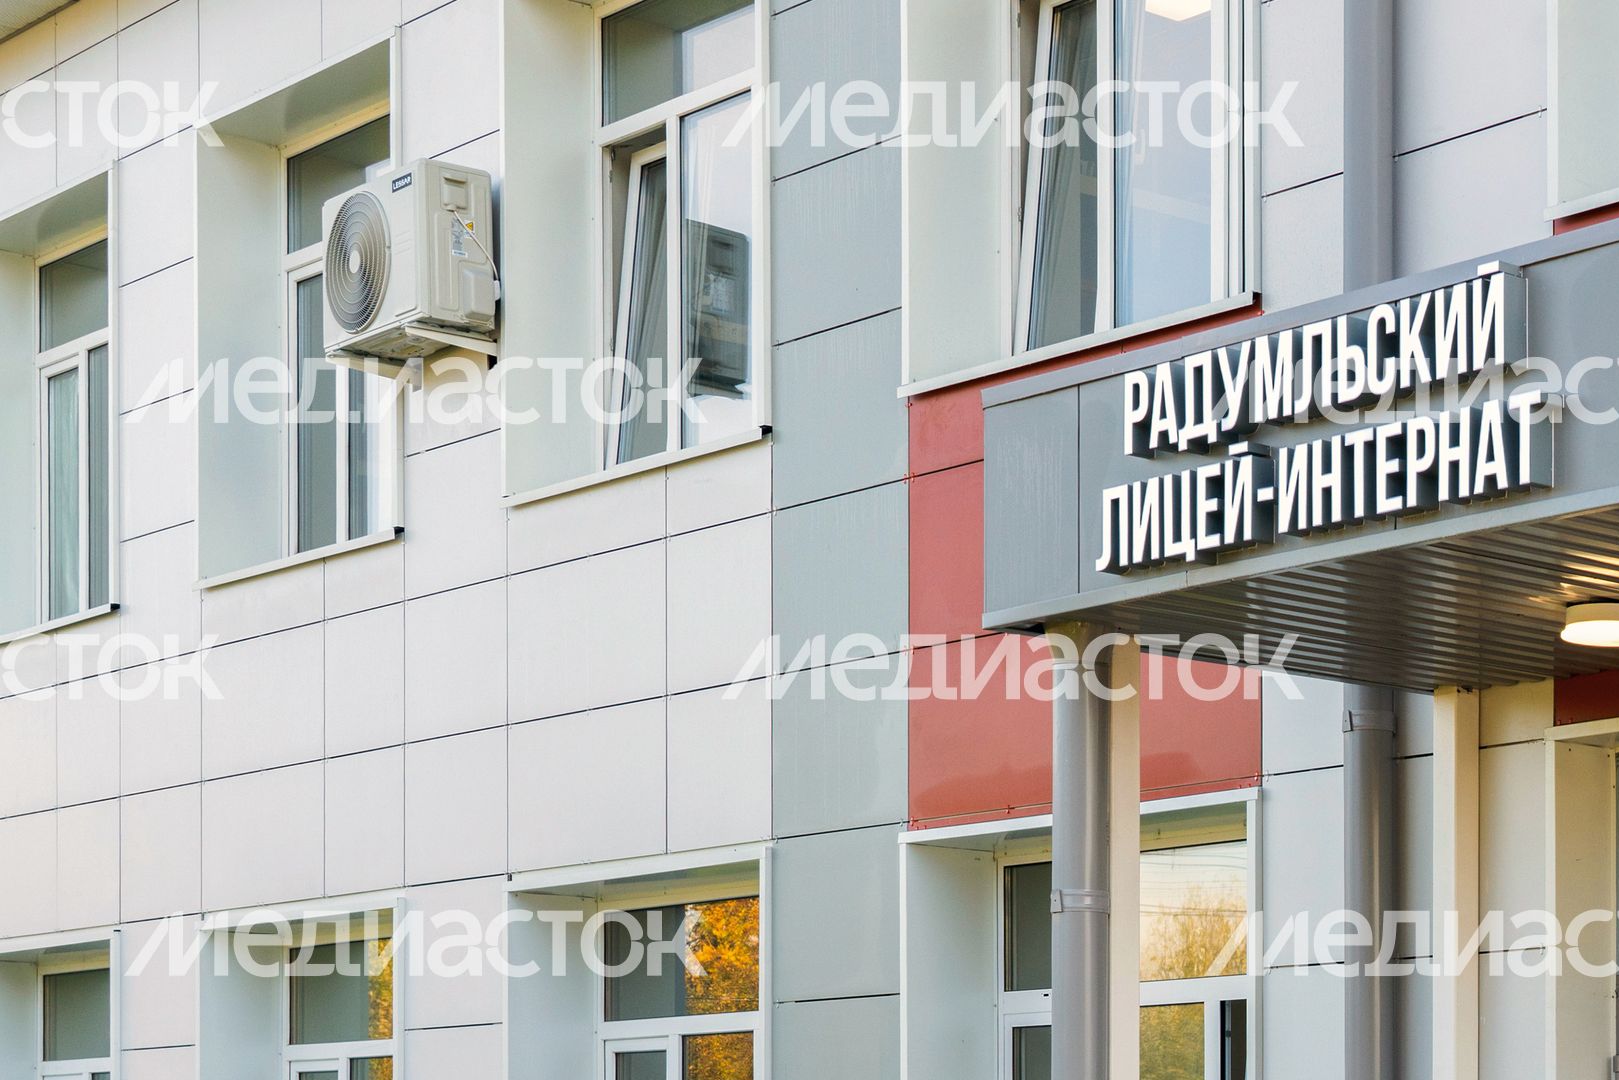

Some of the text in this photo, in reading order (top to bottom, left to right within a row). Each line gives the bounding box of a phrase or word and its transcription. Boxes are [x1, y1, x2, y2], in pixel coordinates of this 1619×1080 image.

[393, 176, 411, 190] LESSAR
[1124, 260, 1505, 456] РАДУМЛЬСКИЙ
[1095, 390, 1544, 572] ЛИЦЕЙ-ИНТЕРНАТ
